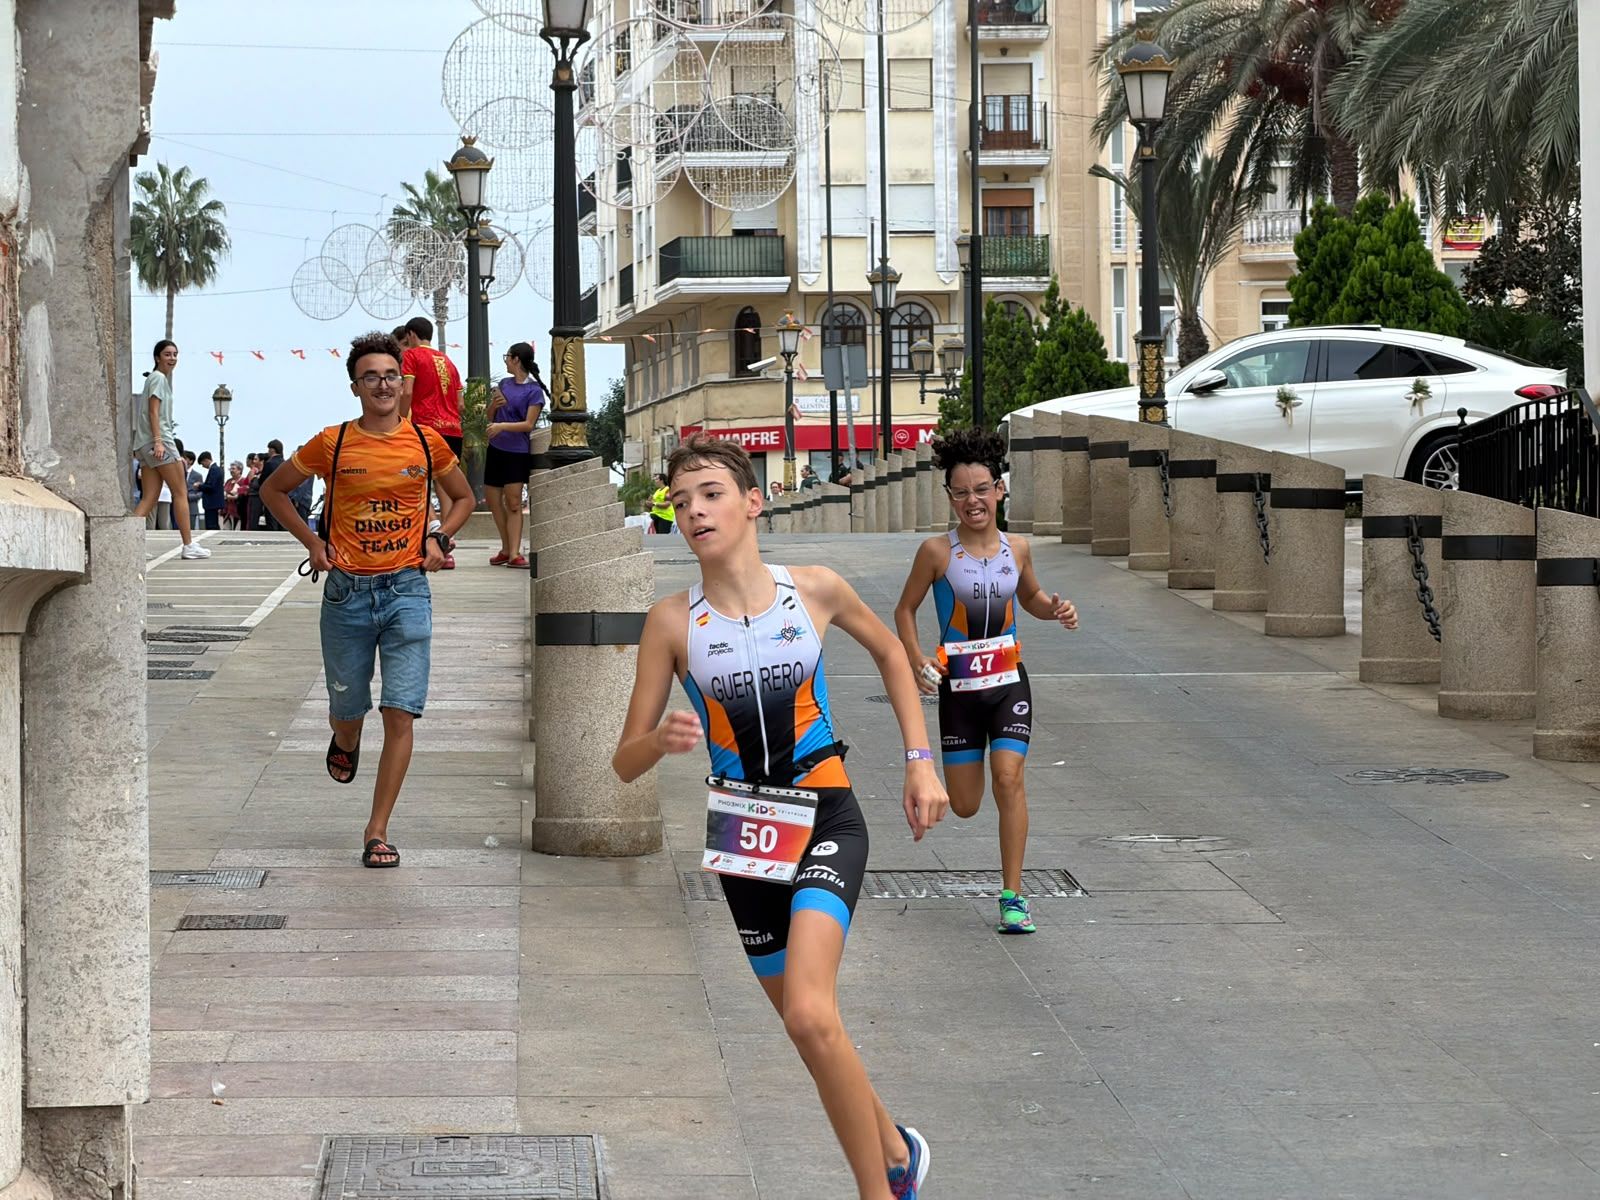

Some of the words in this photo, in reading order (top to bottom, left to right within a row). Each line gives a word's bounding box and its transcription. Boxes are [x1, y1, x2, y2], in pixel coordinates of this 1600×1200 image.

[718, 431, 780, 446] MAPFRE
[368, 499, 399, 512] TRI
[359, 537, 409, 553] TEAM
[973, 581, 1002, 600] BILAL
[707, 646, 734, 658] projects
[708, 641, 729, 650] tactic
[969, 653, 995, 674] 47
[711, 661, 804, 703] GUERRERO
[907, 749, 920, 760] 50
[747, 803, 777, 816] KiDS
[739, 821, 778, 853] 50
